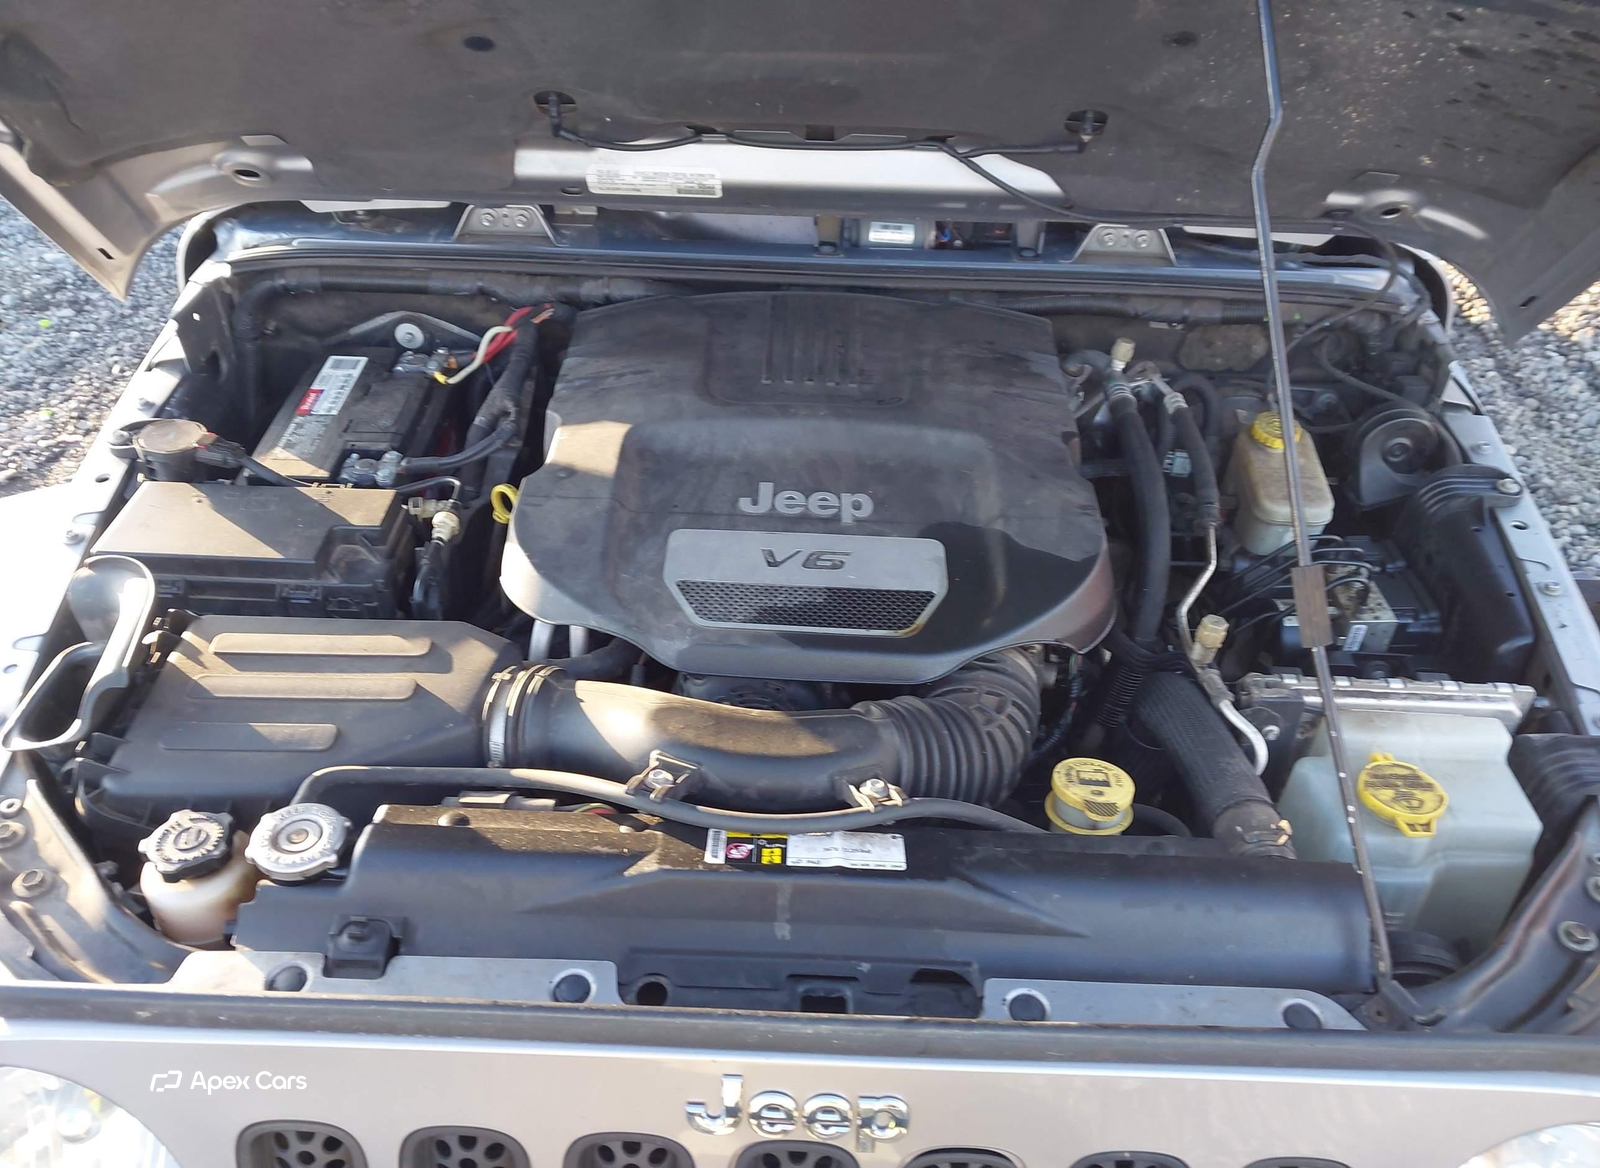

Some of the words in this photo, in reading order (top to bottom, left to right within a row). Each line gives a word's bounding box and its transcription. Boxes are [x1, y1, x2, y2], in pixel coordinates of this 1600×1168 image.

[738, 481, 874, 525] Jeep
[760, 547, 852, 570] V6
[685, 1074, 911, 1153] Jeep
